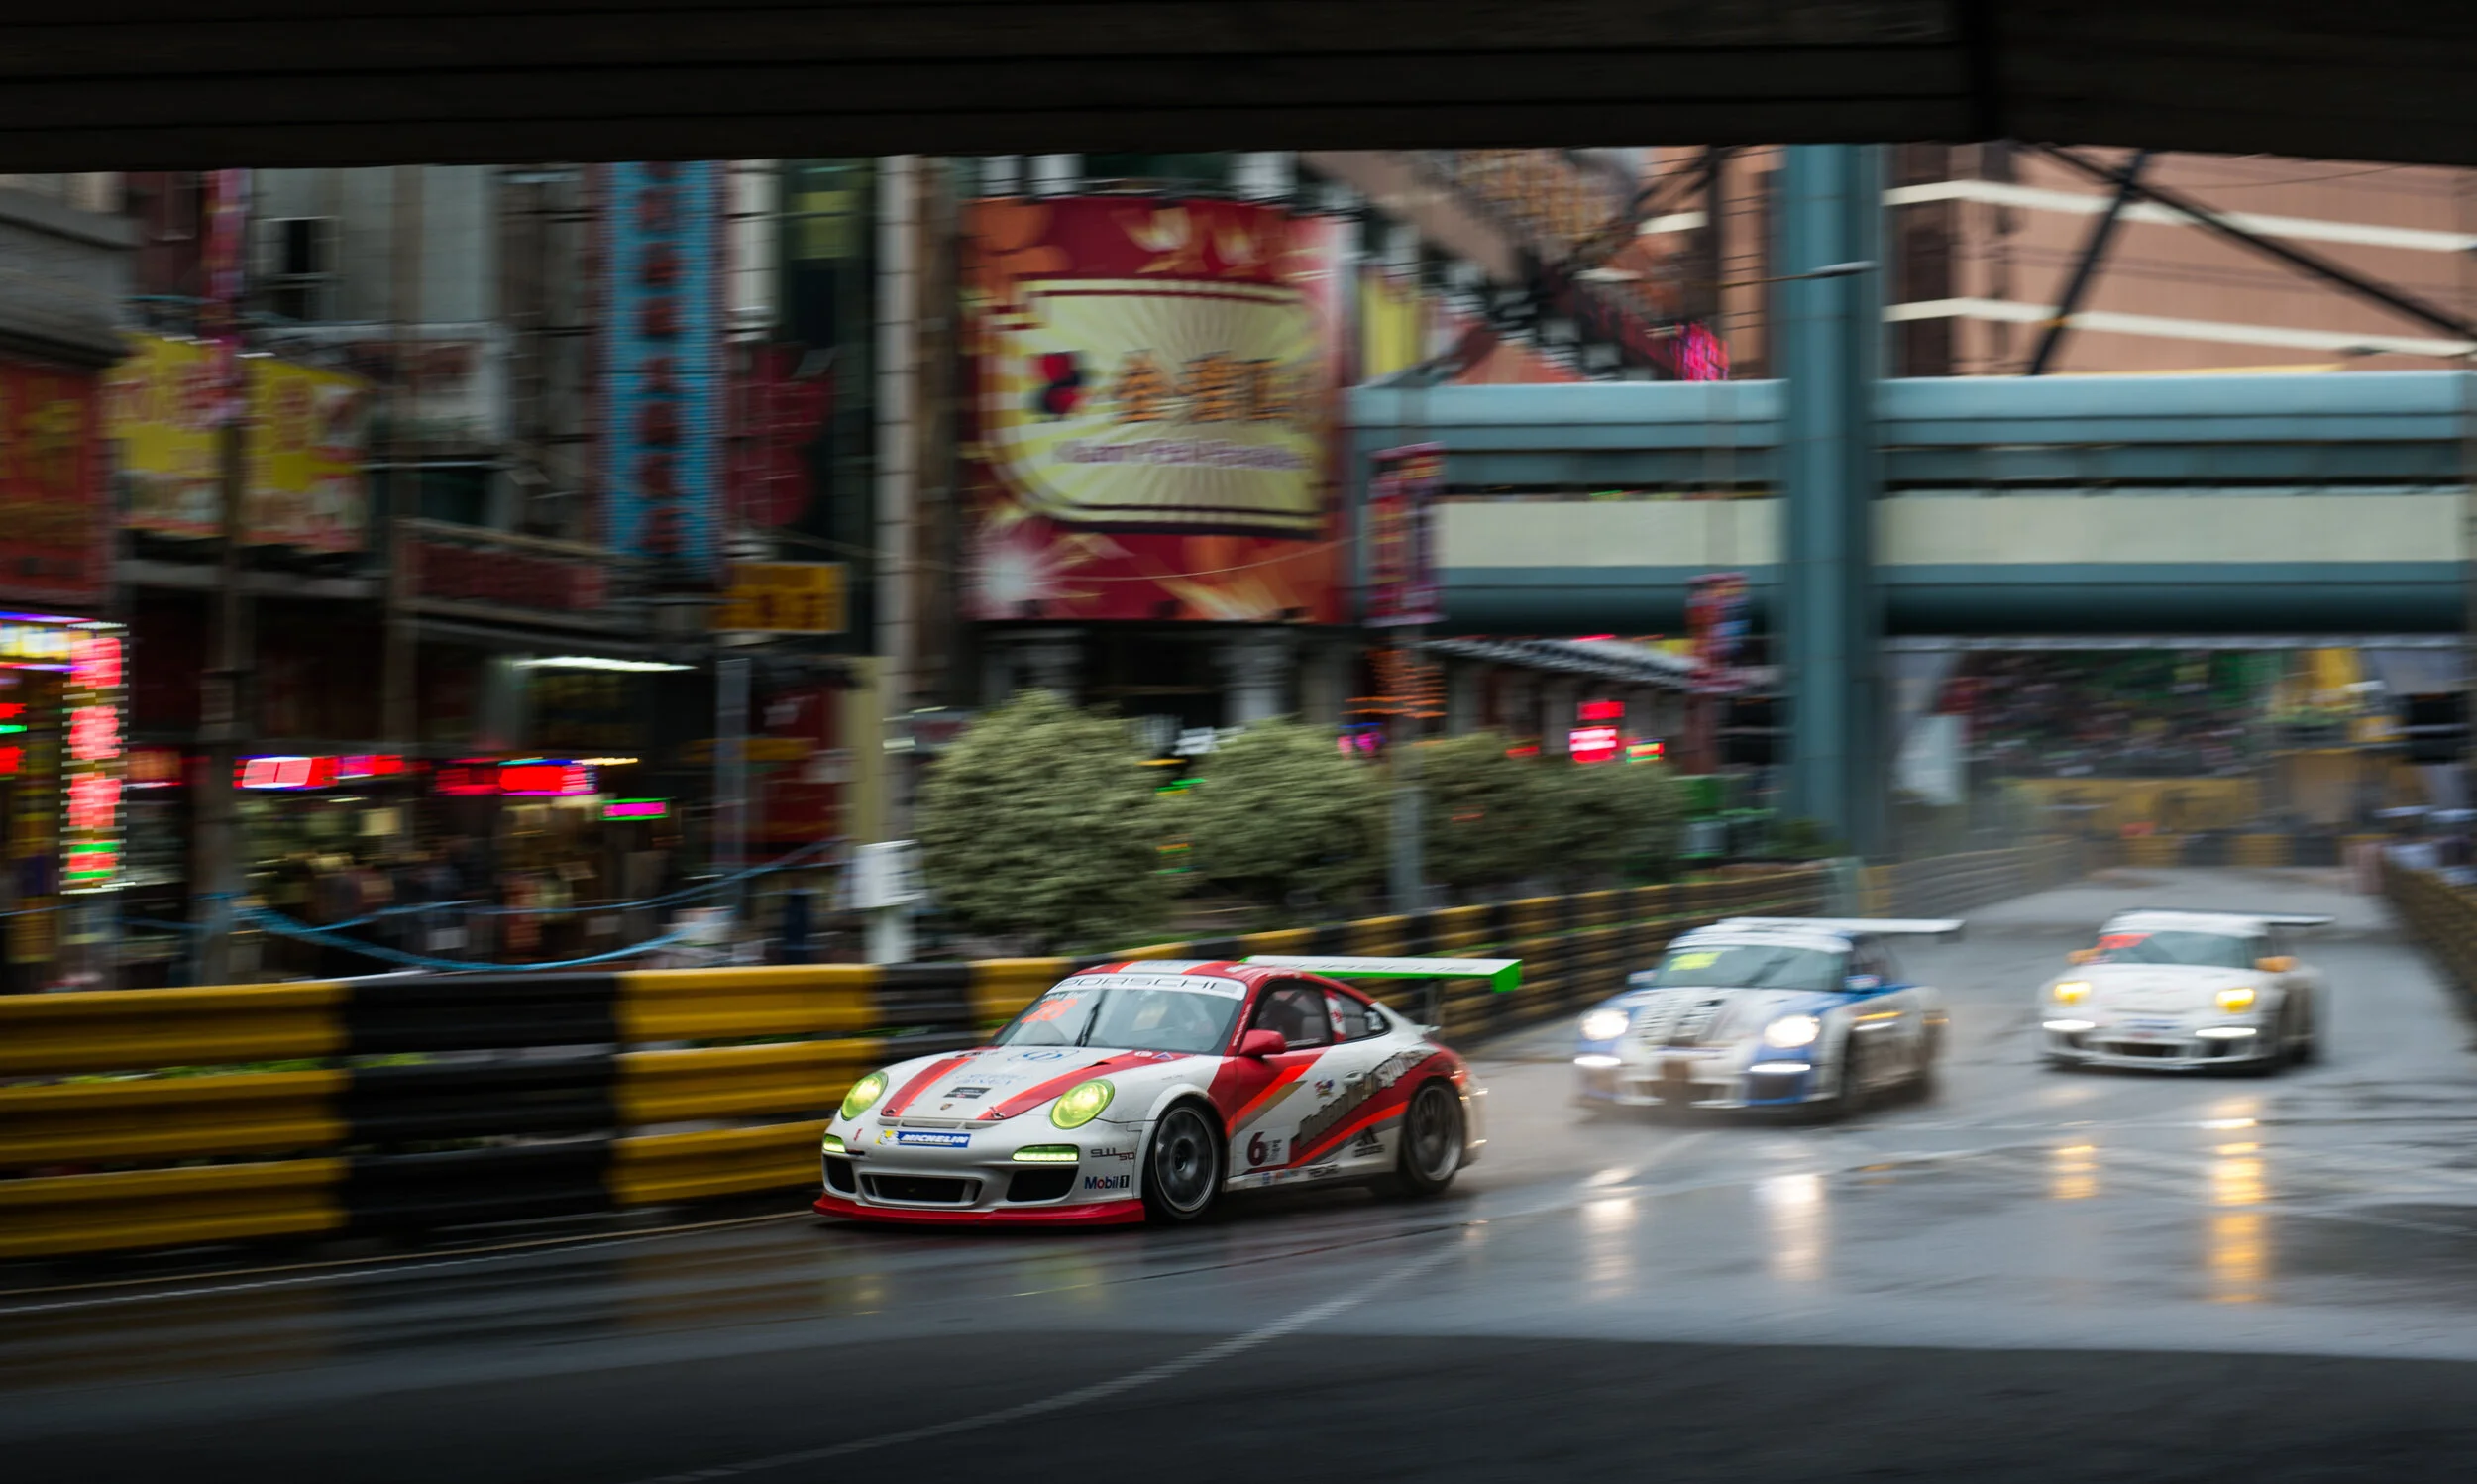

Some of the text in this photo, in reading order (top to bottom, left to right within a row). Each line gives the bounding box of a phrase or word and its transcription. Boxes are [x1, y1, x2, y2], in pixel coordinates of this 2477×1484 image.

[900, 1133, 970, 1144] MICHELIN
[1246, 1131, 1268, 1167] 6
[1084, 1175, 1130, 1189] Mobil 1
